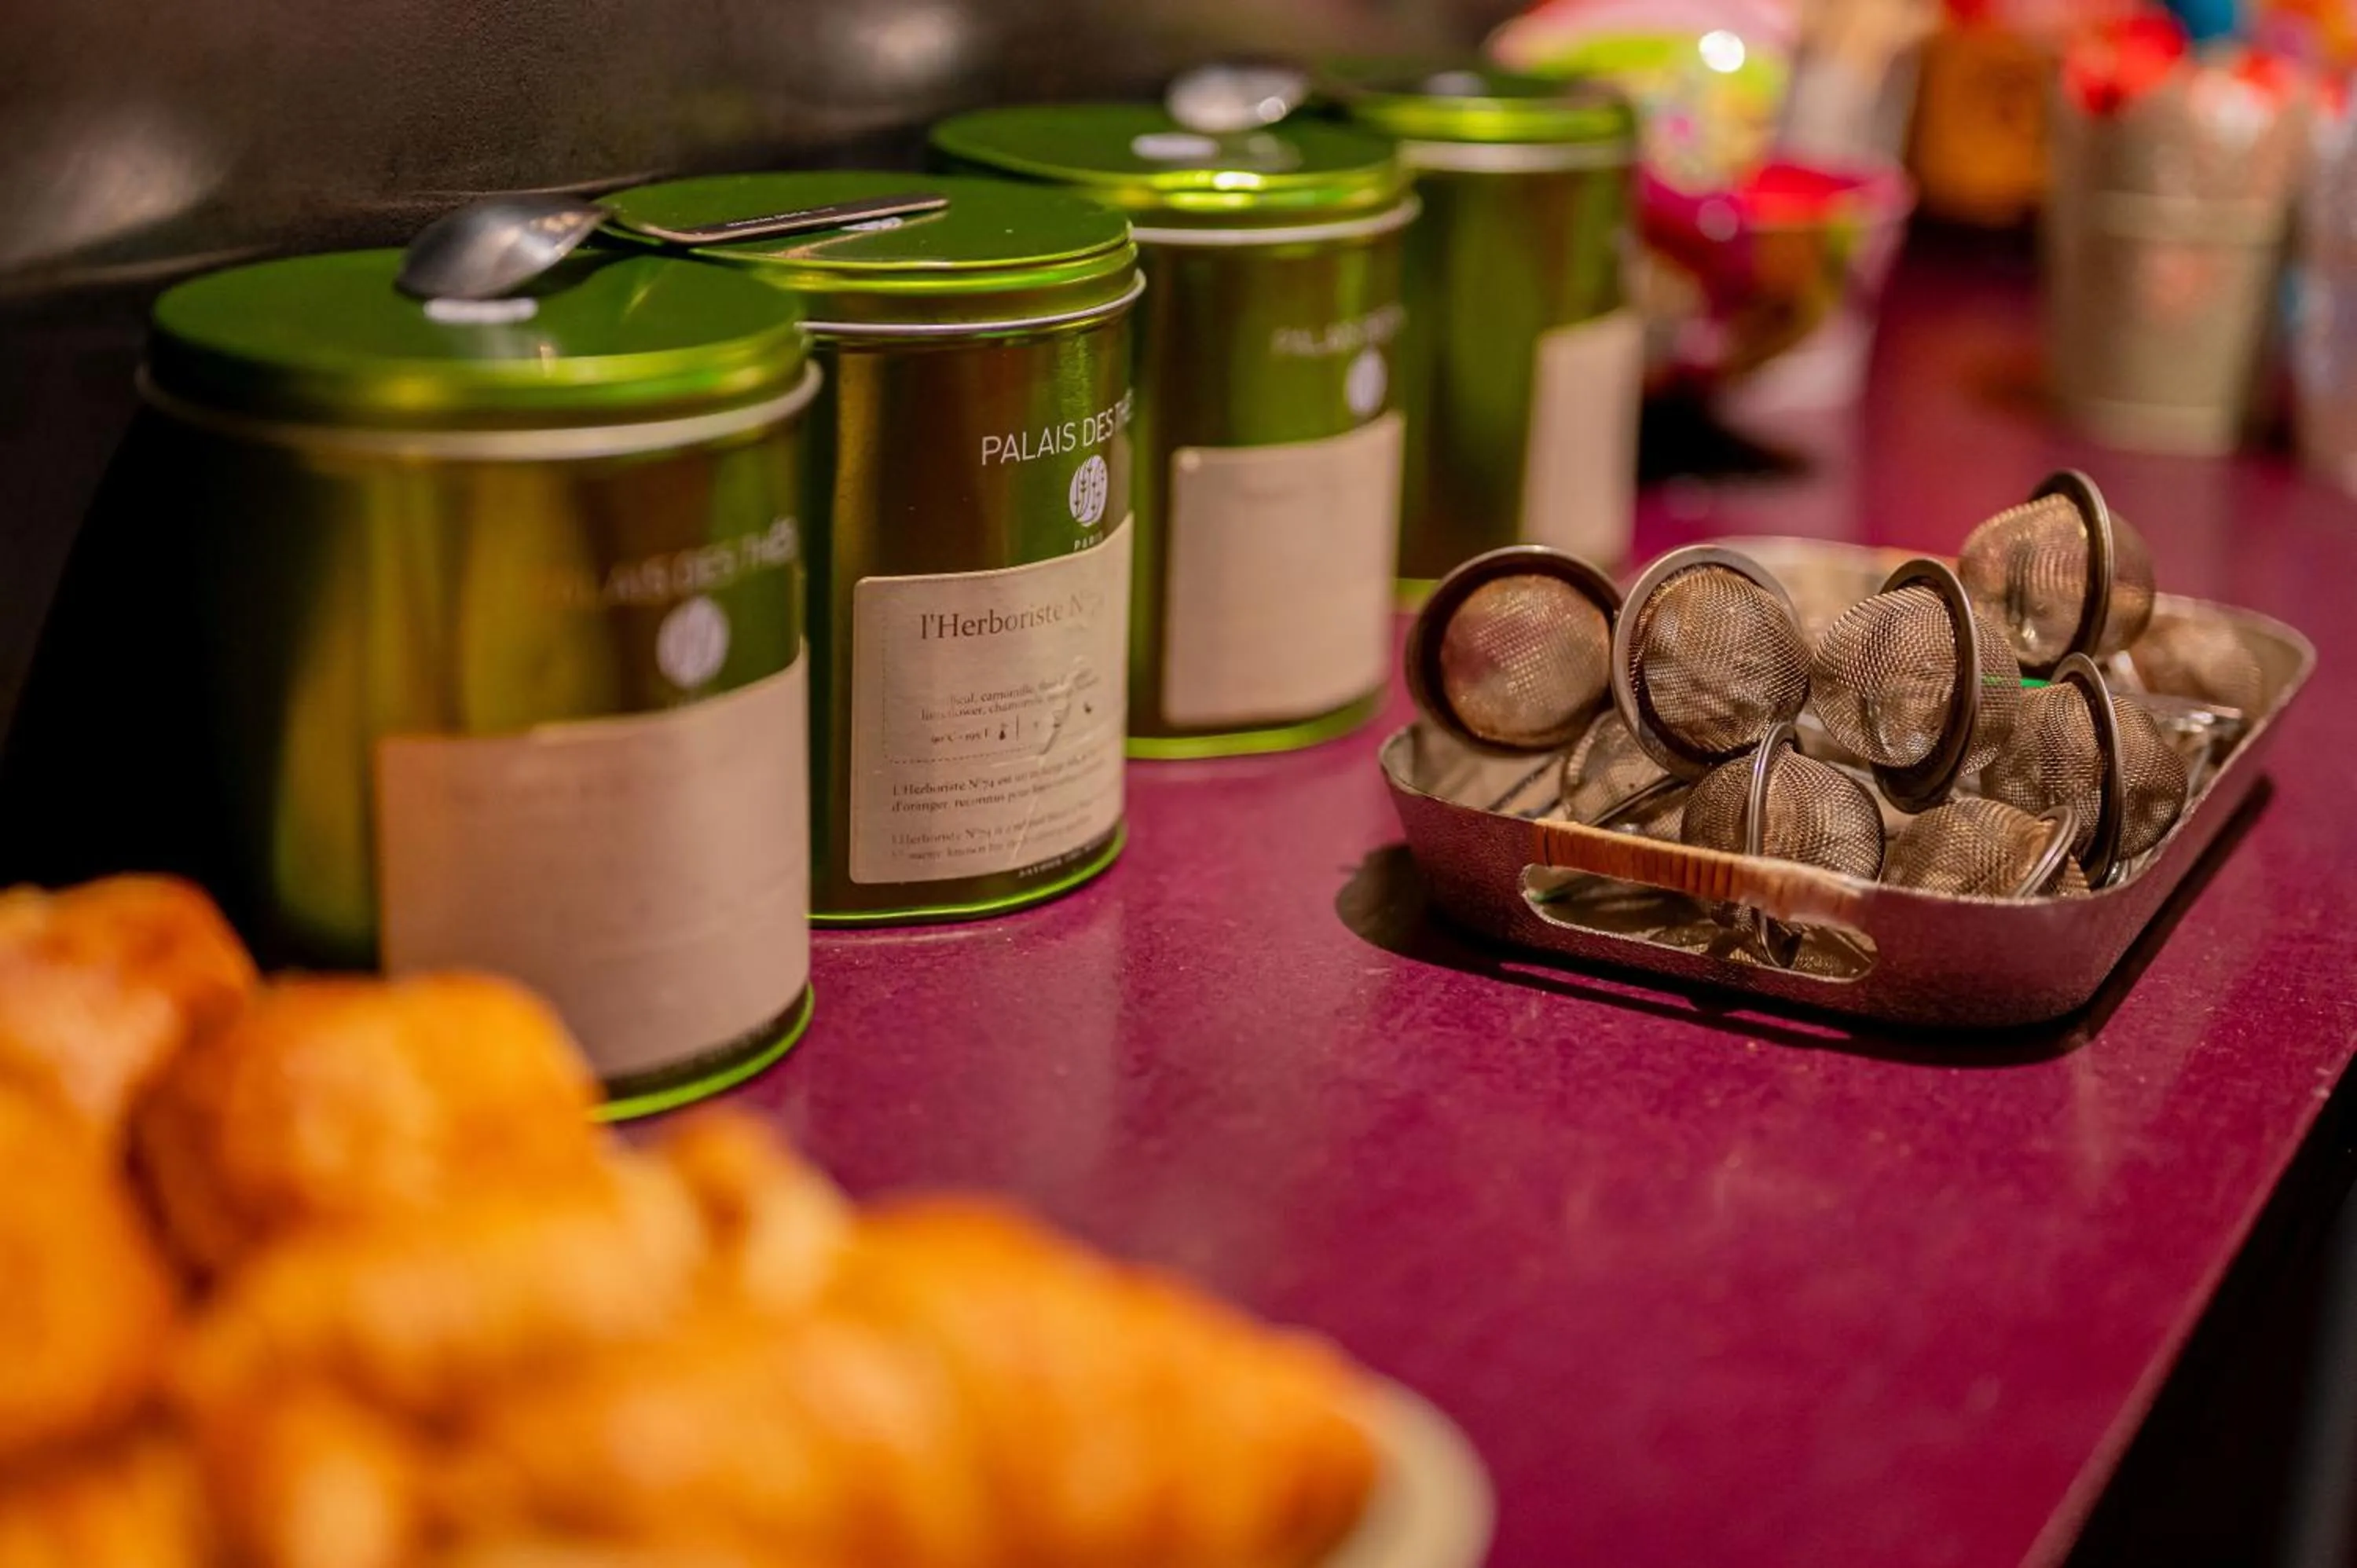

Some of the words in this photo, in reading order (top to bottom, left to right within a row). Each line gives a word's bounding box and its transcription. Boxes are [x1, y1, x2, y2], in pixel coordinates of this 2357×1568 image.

[981, 423, 1076, 466] PALAIS
[1083, 408, 1114, 447] DES
[921, 604, 1064, 639] l'Herboriste
